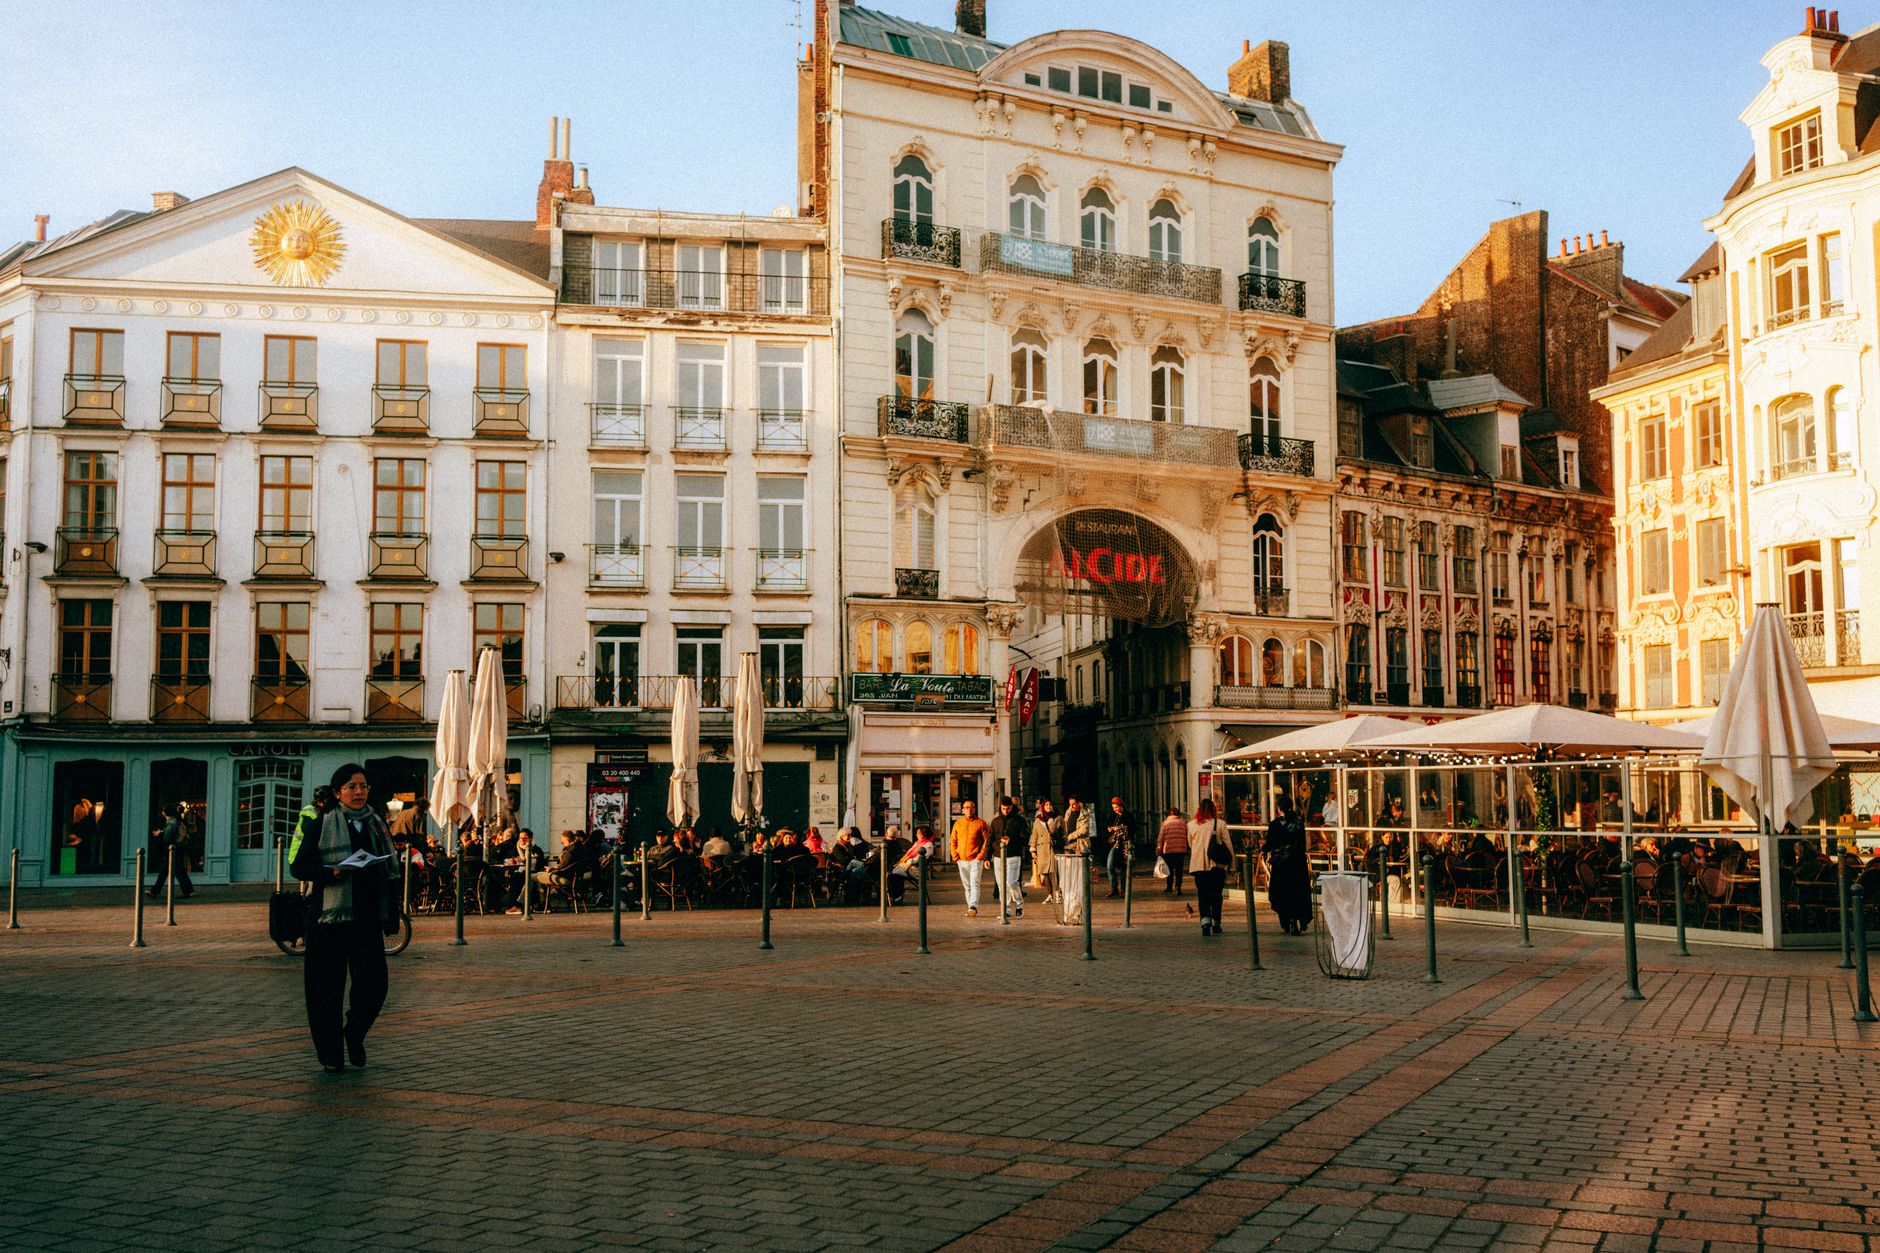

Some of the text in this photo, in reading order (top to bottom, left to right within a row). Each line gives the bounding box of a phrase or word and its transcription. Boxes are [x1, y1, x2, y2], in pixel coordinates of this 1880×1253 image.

[1046, 545, 1166, 584] ALCIDE
[859, 677, 986, 693] BAR La Voute TABAC
[1023, 681, 1034, 714] TABAC
[229, 743, 308, 756] CAROLL
